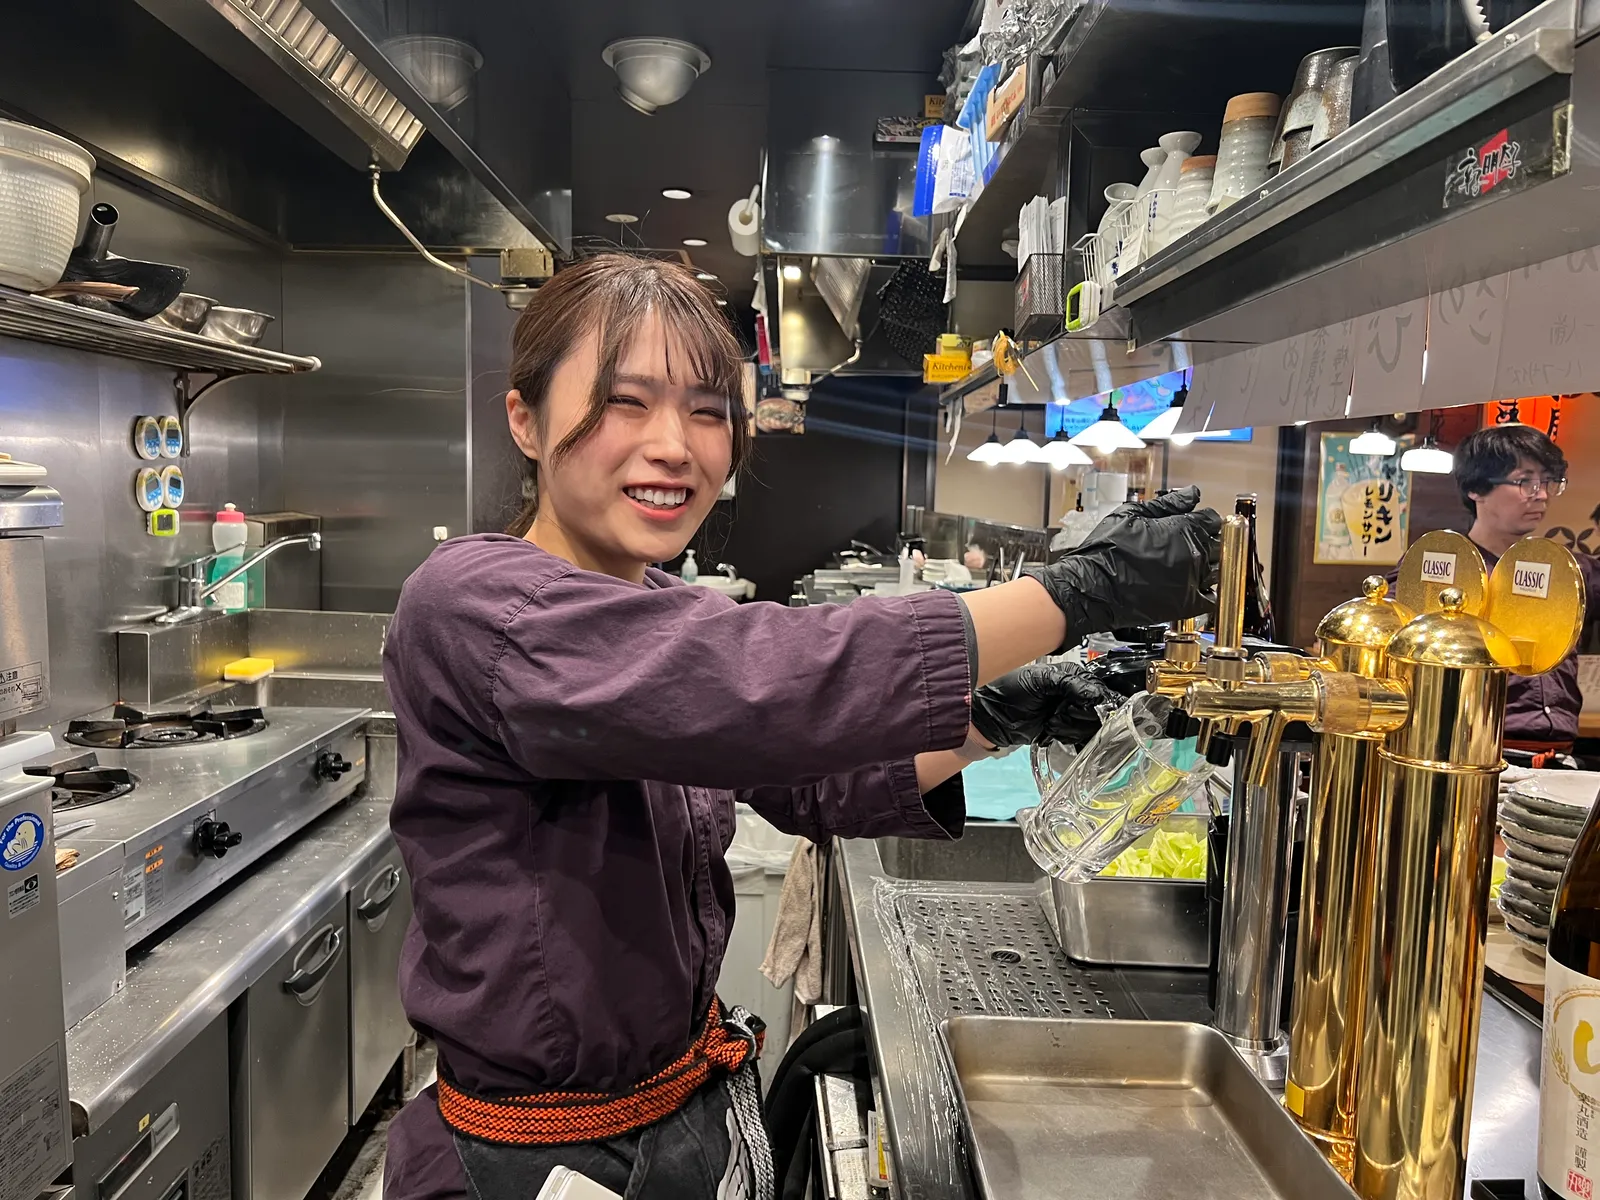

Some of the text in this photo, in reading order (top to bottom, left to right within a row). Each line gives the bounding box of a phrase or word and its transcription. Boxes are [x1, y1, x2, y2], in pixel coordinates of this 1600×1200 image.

[1362, 486, 1373, 556] レモンサワー
[1423, 559, 1452, 577] CLASSIC
[1514, 569, 1546, 589] CLASSIC
